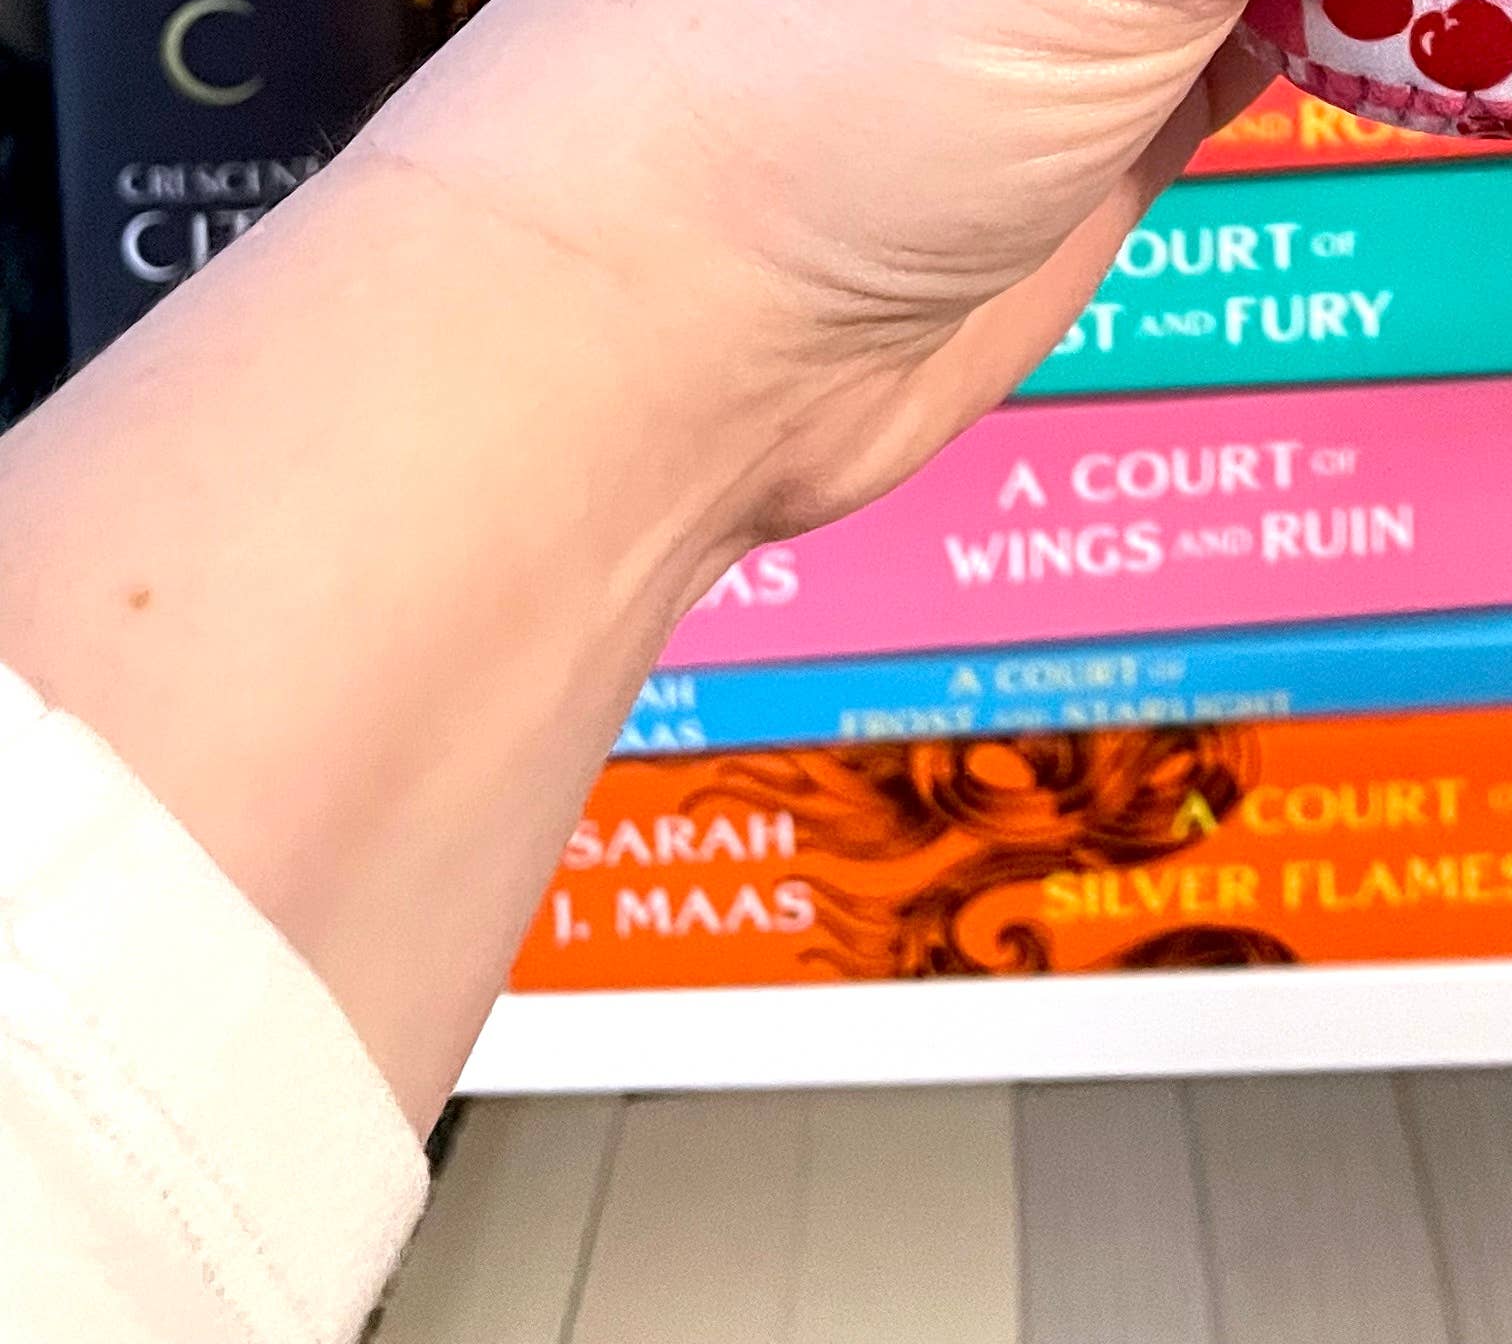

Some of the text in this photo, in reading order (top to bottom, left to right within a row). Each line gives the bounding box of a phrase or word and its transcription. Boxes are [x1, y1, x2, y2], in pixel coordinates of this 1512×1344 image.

[1112, 223, 1359, 279] OURT OF
[1136, 309, 1217, 338] AND
[1224, 290, 1394, 347] FURY
[1000, 458, 1047, 511] A
[1071, 441, 1303, 503] COURT
[943, 504, 1414, 586] WINGS AND RUIN
[562, 810, 797, 869] SARAH
[1170, 789, 1220, 842] A
[1240, 776, 1469, 837] COURT
[615, 880, 817, 939] MAAS
[1042, 864, 1261, 921] SILVER
